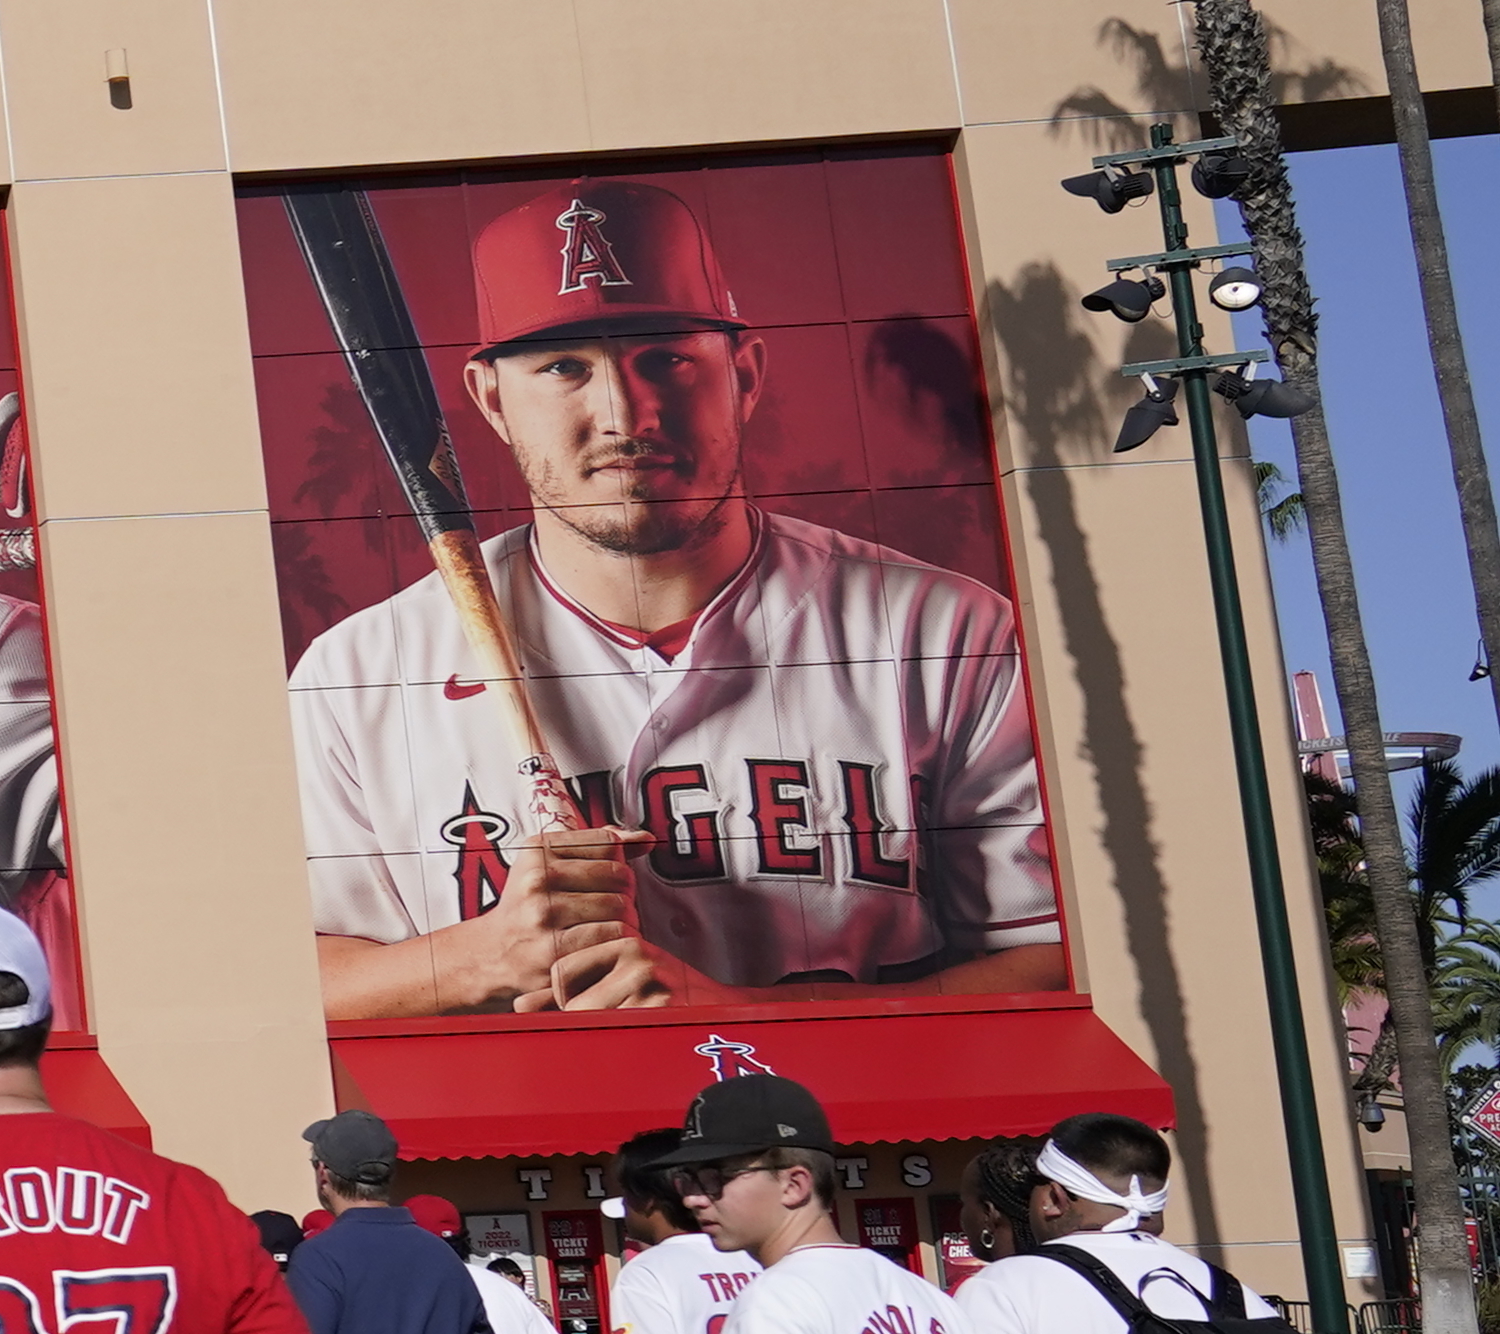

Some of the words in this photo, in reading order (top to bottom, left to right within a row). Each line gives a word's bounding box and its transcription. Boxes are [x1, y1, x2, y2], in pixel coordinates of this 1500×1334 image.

[558, 197, 632, 296] A
[520, 1155, 932, 1200] TITS
[864, 1226, 901, 1237] TICKET
[477, 1239, 520, 1249] TICKETS
[551, 1237, 589, 1249] TICKET
[870, 1236, 899, 1246] SALES
[558, 1247, 587, 1258] SALES
[698, 1271, 762, 1303] TRO
